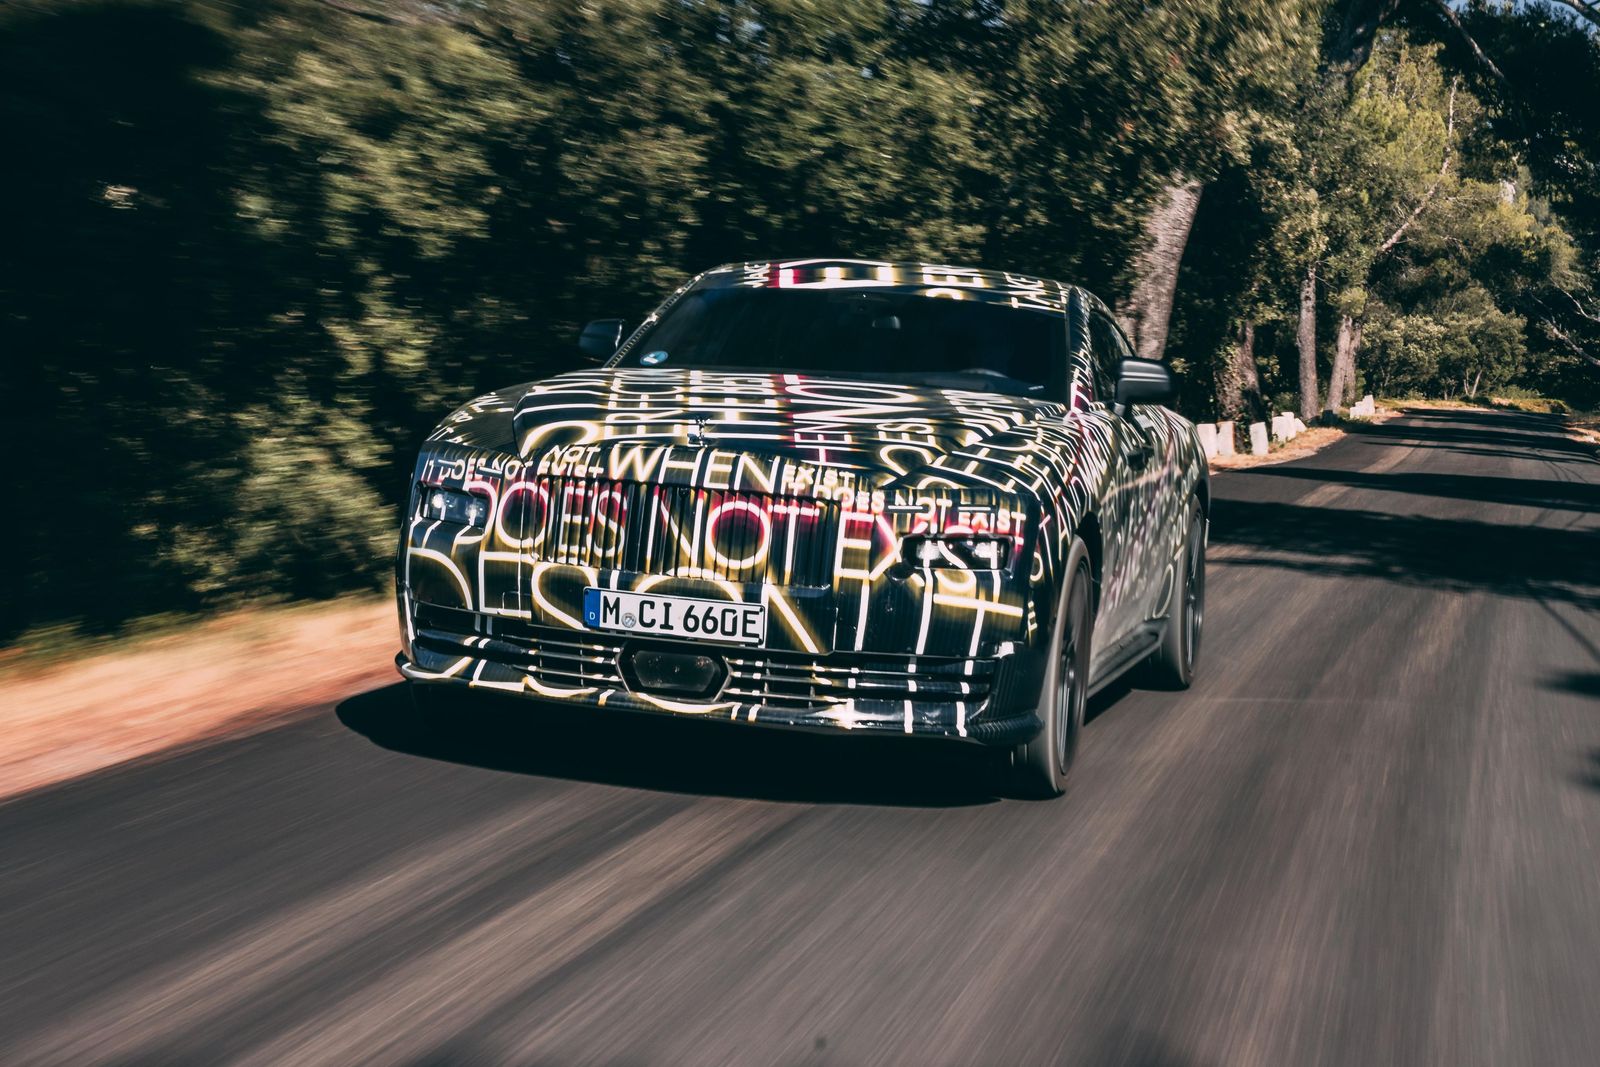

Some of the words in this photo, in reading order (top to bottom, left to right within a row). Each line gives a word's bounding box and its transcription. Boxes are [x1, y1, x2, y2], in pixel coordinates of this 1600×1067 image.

[609, 443, 780, 493] WHEN
[643, 484, 820, 586] NOT
[602, 595, 621, 625] M
[639, 600, 674, 630] CI
[683, 605, 761, 638] 660E
